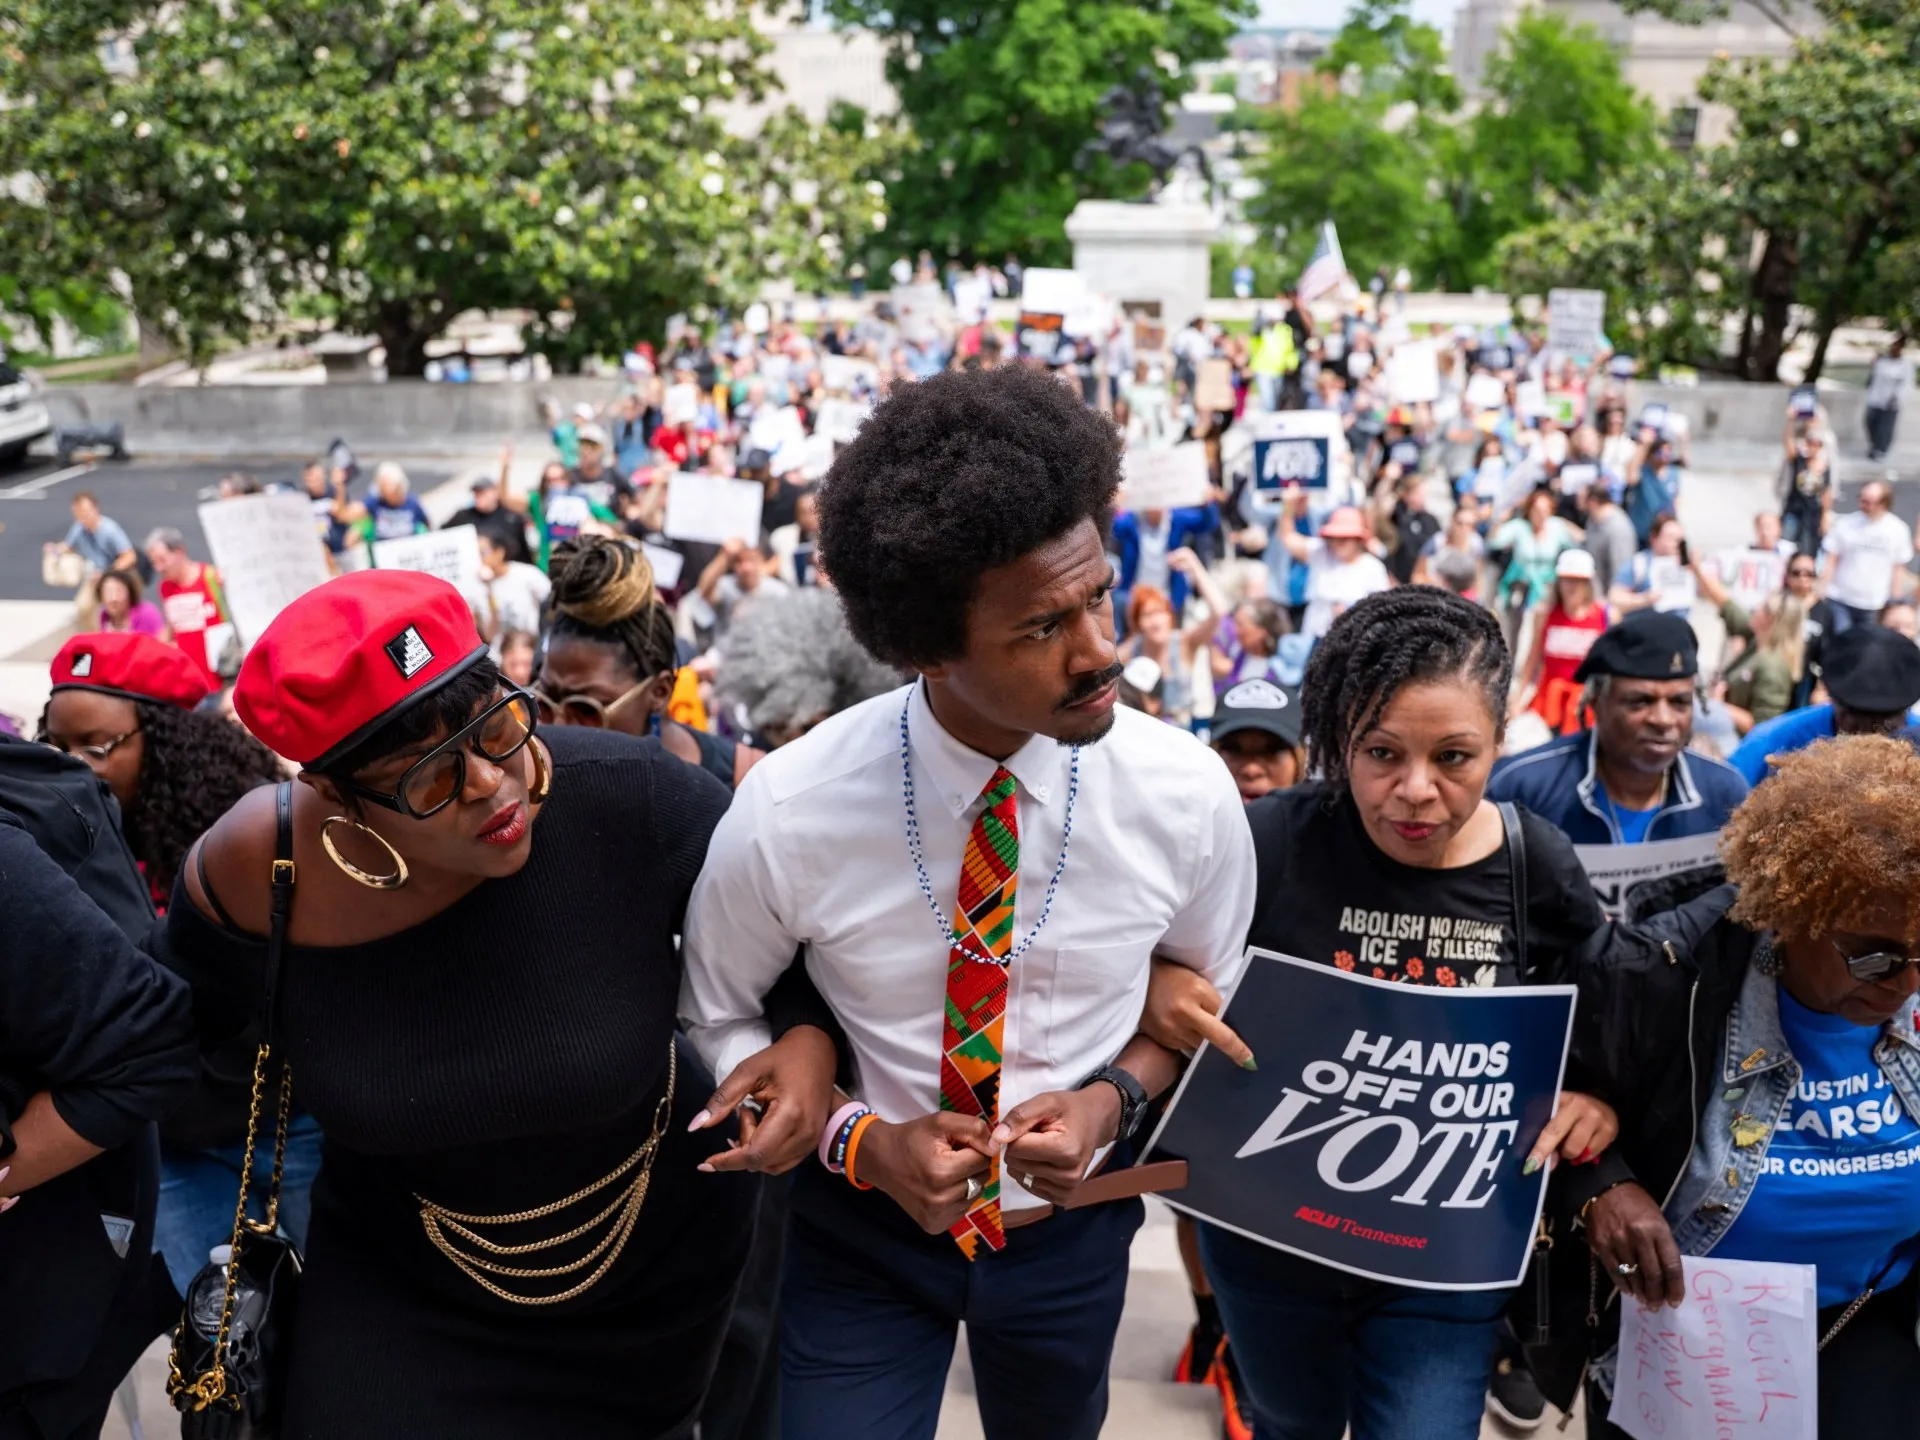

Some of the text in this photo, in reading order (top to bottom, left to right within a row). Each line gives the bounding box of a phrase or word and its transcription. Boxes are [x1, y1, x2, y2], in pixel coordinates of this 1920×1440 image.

[407, 636, 417, 645] BET
[409, 647, 424, 661] BLACK
[411, 653, 429, 667] WOMEN
[1588, 863, 1663, 878] PROTECT
[1339, 906, 1425, 940] ABOLISH
[1429, 916, 1503, 942] NO HUMAN
[1359, 936, 1399, 965] ICE
[1426, 938, 1502, 962] IS ILLEGAL
[1341, 1029, 1511, 1078] HANDS
[1301, 1060, 1515, 1118] OFF OUR
[1774, 1093, 1902, 1140] EARSO
[1234, 1086, 1519, 1208] VOTE
[1758, 1145, 1920, 1176] UR CONGRESSM
[1294, 1205, 1428, 1249] ACLU Tennessee
